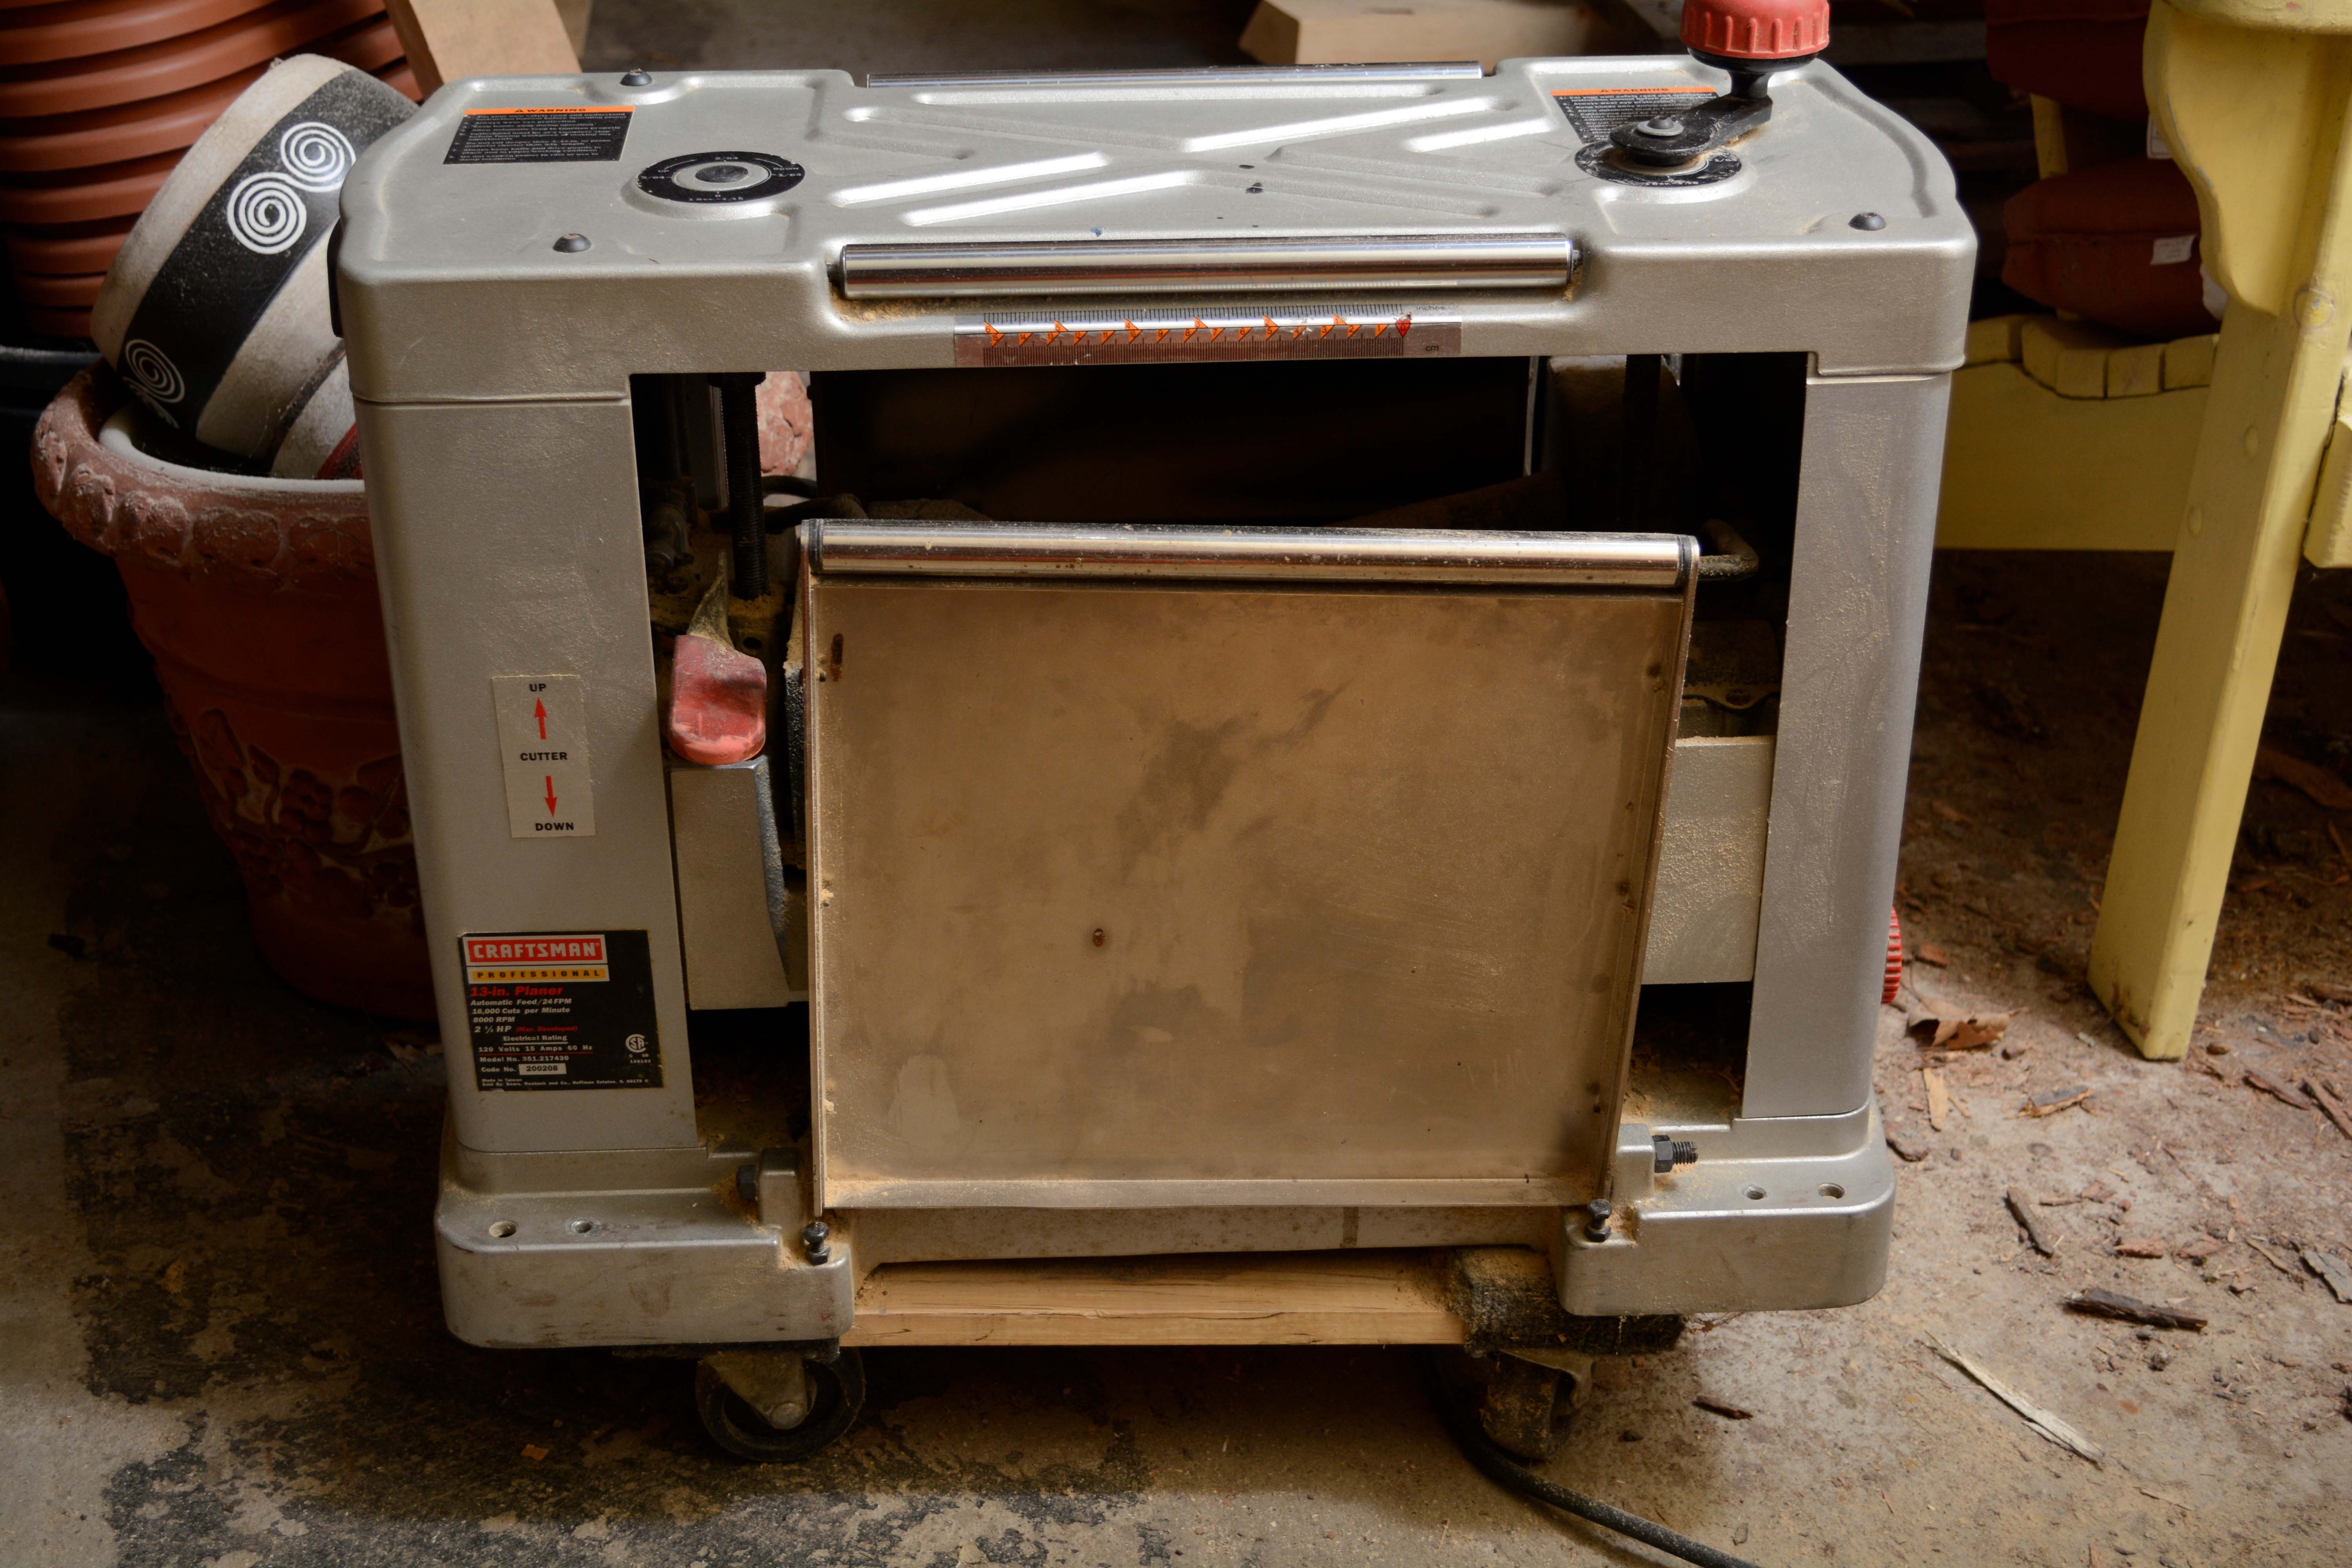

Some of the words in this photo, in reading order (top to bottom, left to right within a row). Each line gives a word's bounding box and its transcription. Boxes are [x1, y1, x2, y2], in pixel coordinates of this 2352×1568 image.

[1185, 328, 1191, 337] 8
[1349, 325, 1355, 333] 2
[529, 683, 546, 692] UP
[520, 752, 568, 761] CUTTER
[535, 822, 574, 831] DOWN
[470, 986, 510, 997] 13-in.
[515, 986, 564, 996] Planer
